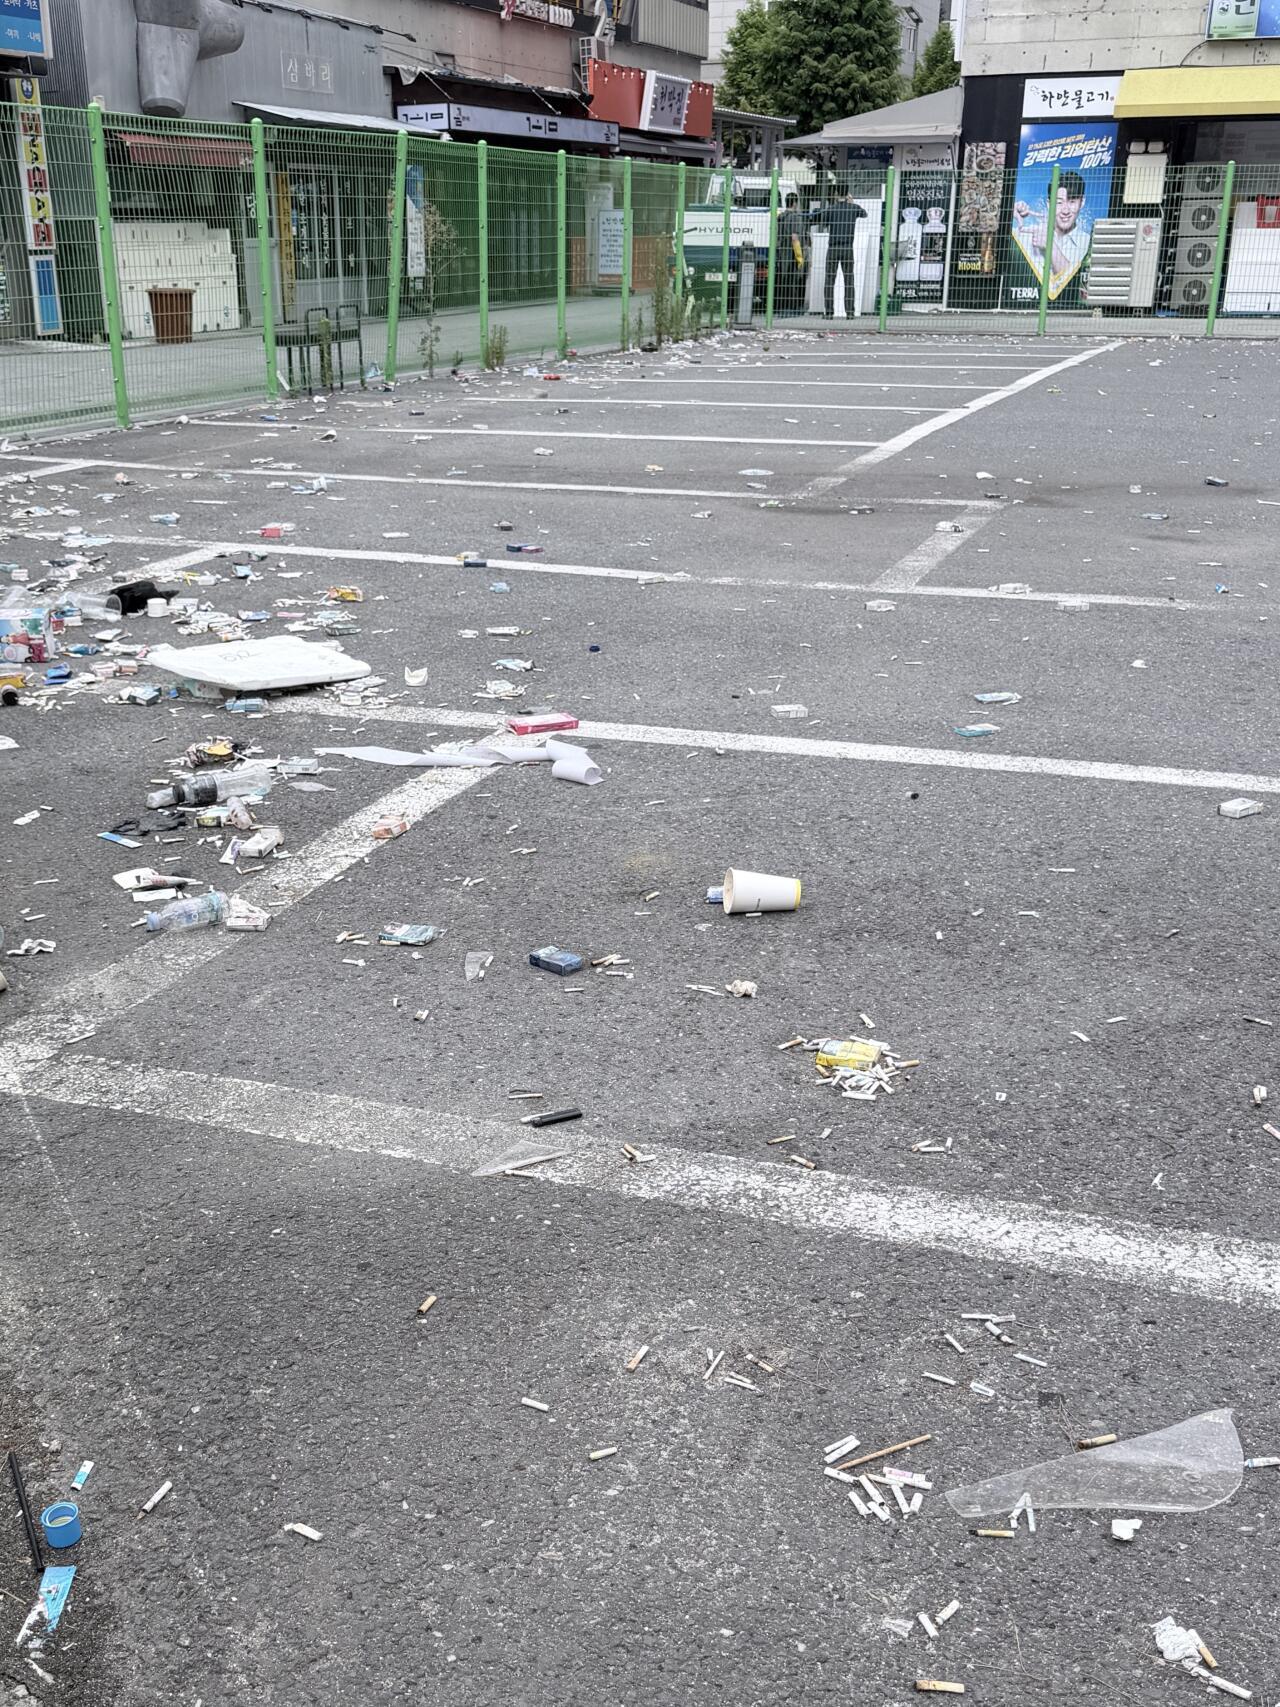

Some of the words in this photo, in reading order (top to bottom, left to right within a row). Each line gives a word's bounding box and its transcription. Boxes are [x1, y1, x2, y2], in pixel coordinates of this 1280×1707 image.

[1041, 90, 1110, 109] 하얀물고기
[1023, 145, 1062, 166] 강력한
[1080, 150, 1112, 169] 100%
[1011, 287, 1039, 299] TERRA
